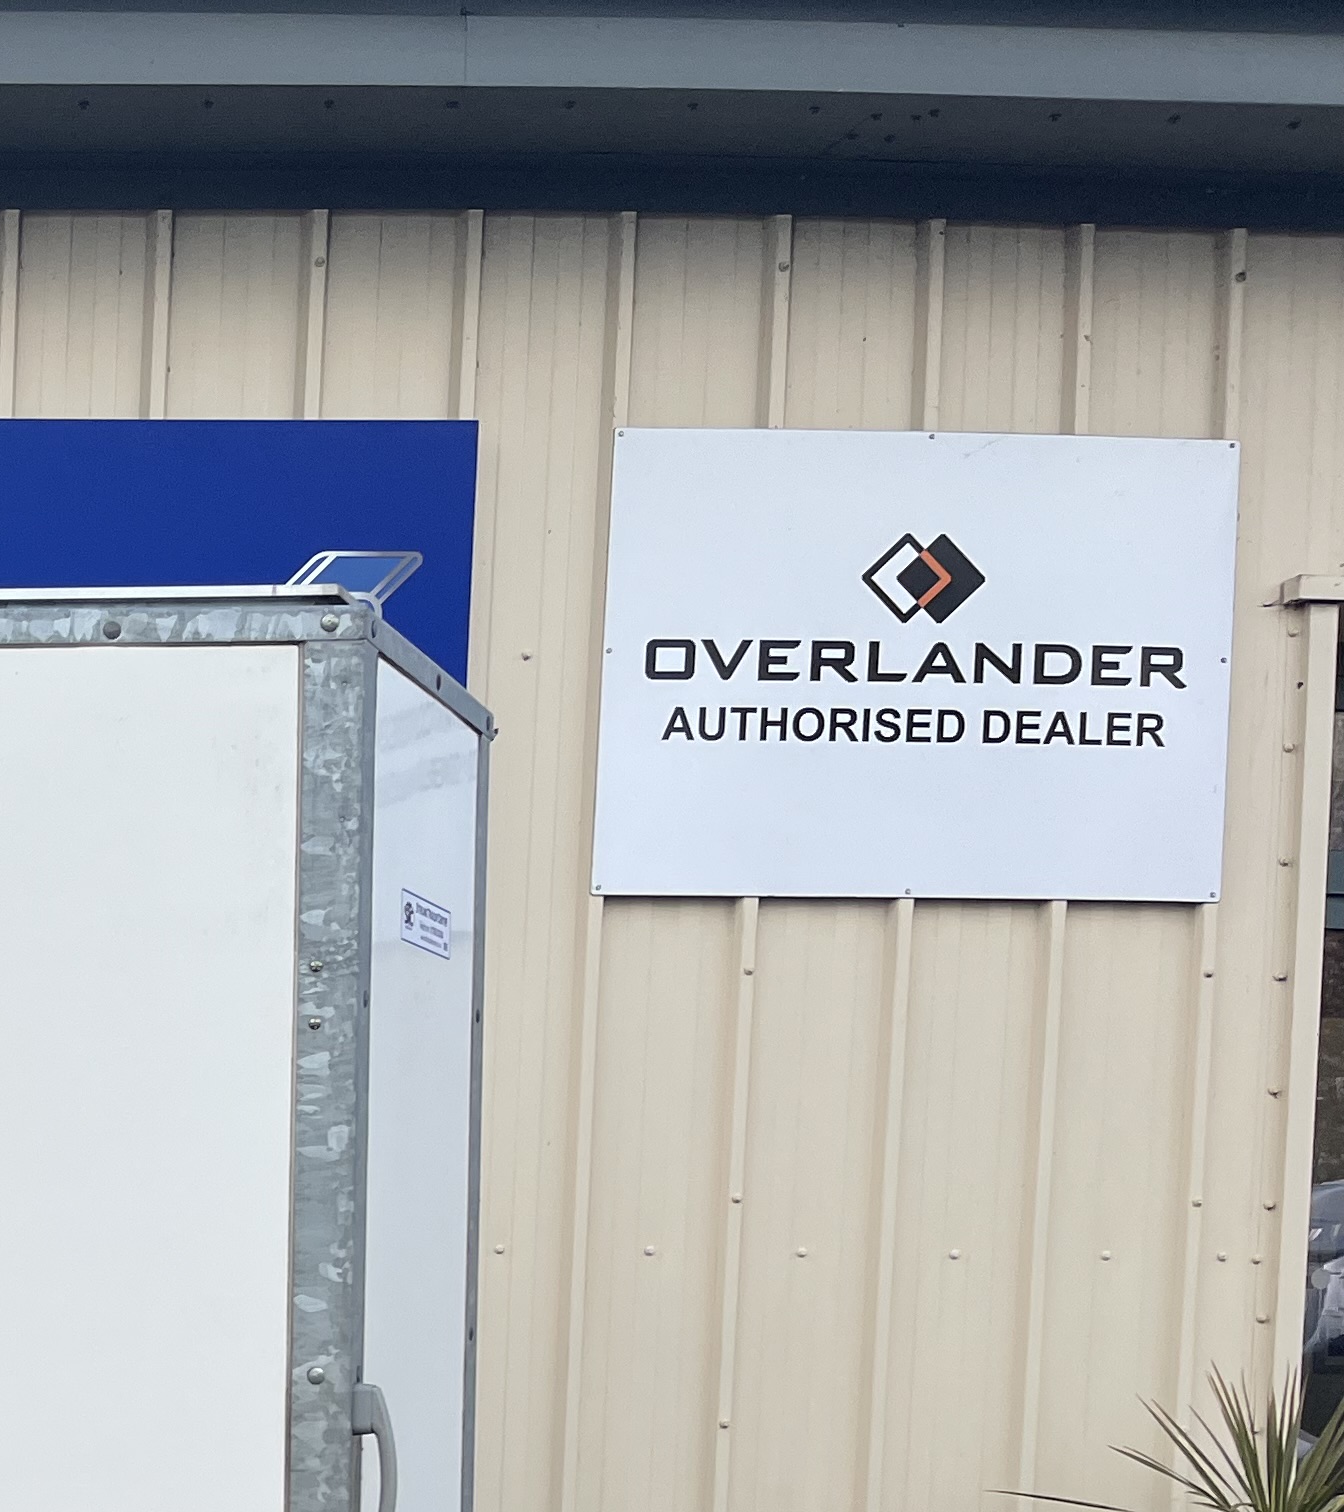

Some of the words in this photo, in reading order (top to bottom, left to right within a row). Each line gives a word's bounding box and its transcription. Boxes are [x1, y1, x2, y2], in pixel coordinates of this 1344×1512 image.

[645, 638, 1187, 689] OVERLANDER
[661, 706, 966, 744] AUTHORISED
[982, 709, 1165, 748] DEALER
